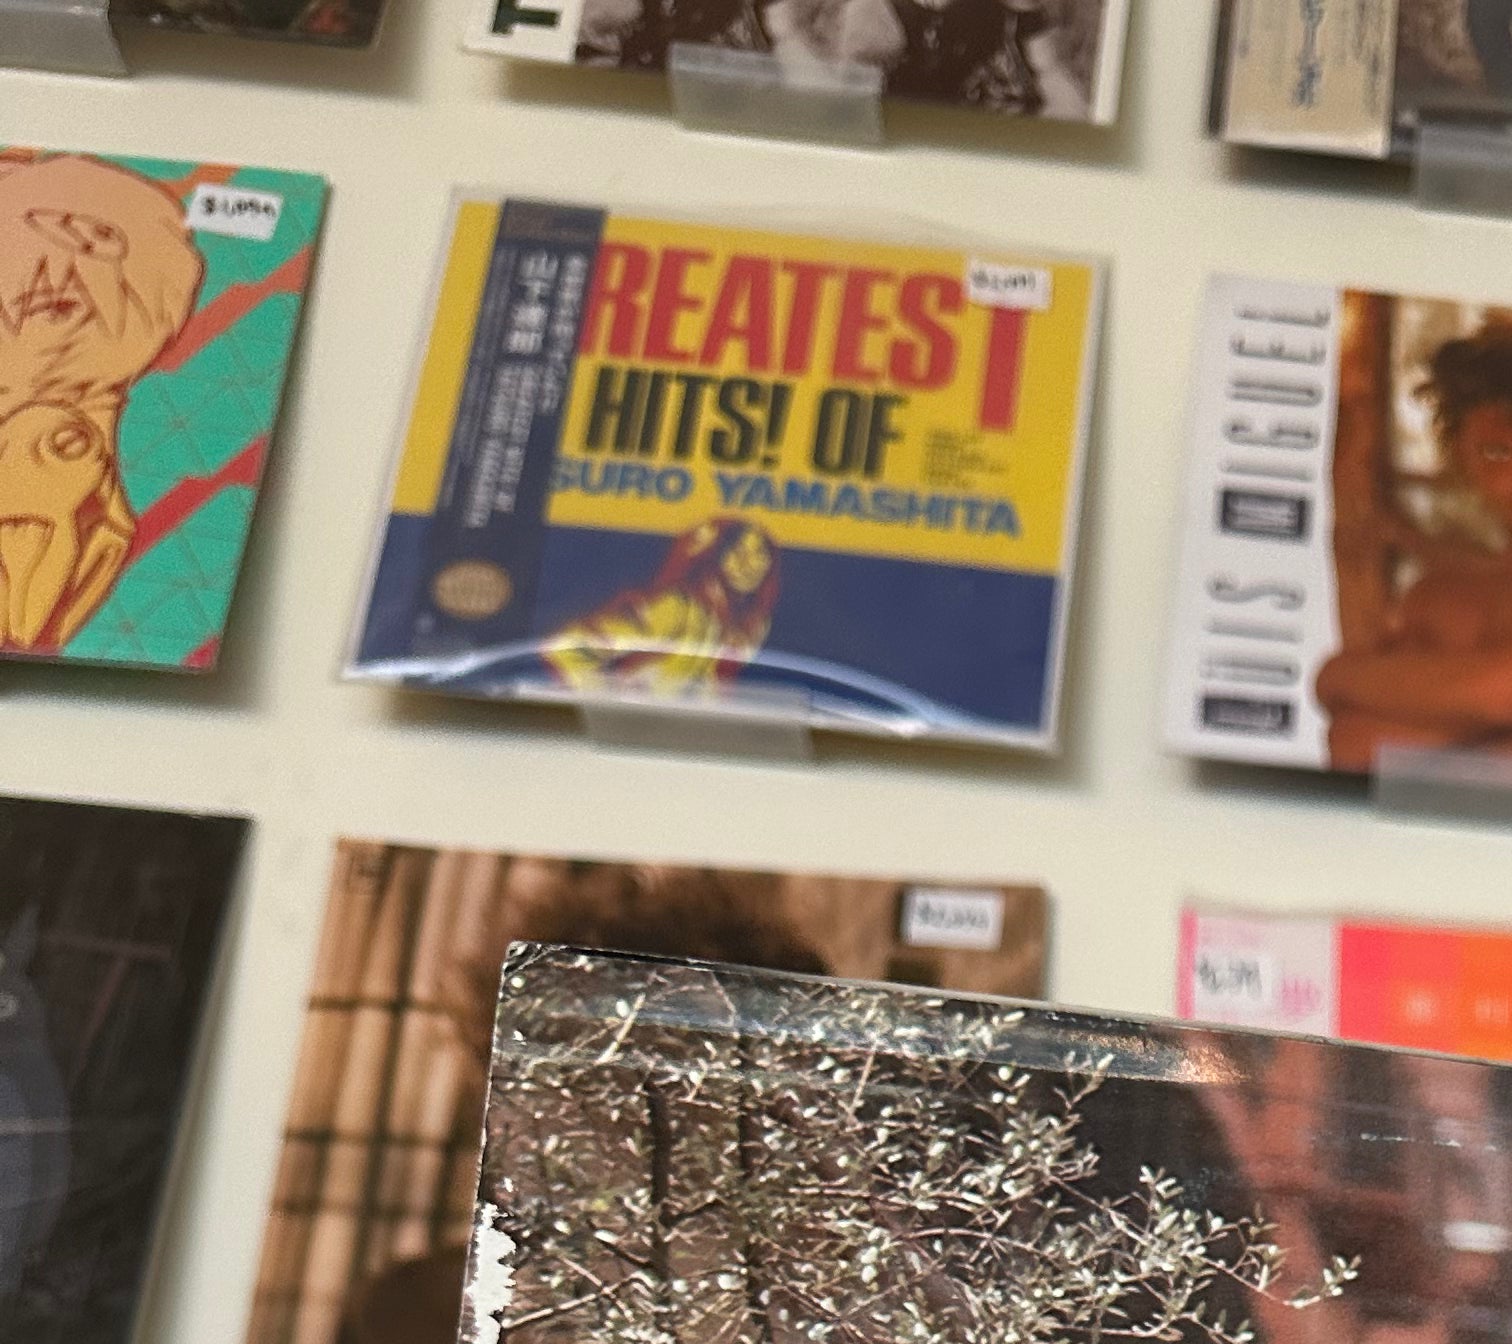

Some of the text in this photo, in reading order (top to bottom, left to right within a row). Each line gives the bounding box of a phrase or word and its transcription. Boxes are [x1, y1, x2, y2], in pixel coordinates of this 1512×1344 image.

[584, 364, 792, 470] HITS!
[808, 387, 910, 480] OF
[713, 470, 1023, 540] YAMASHITA
